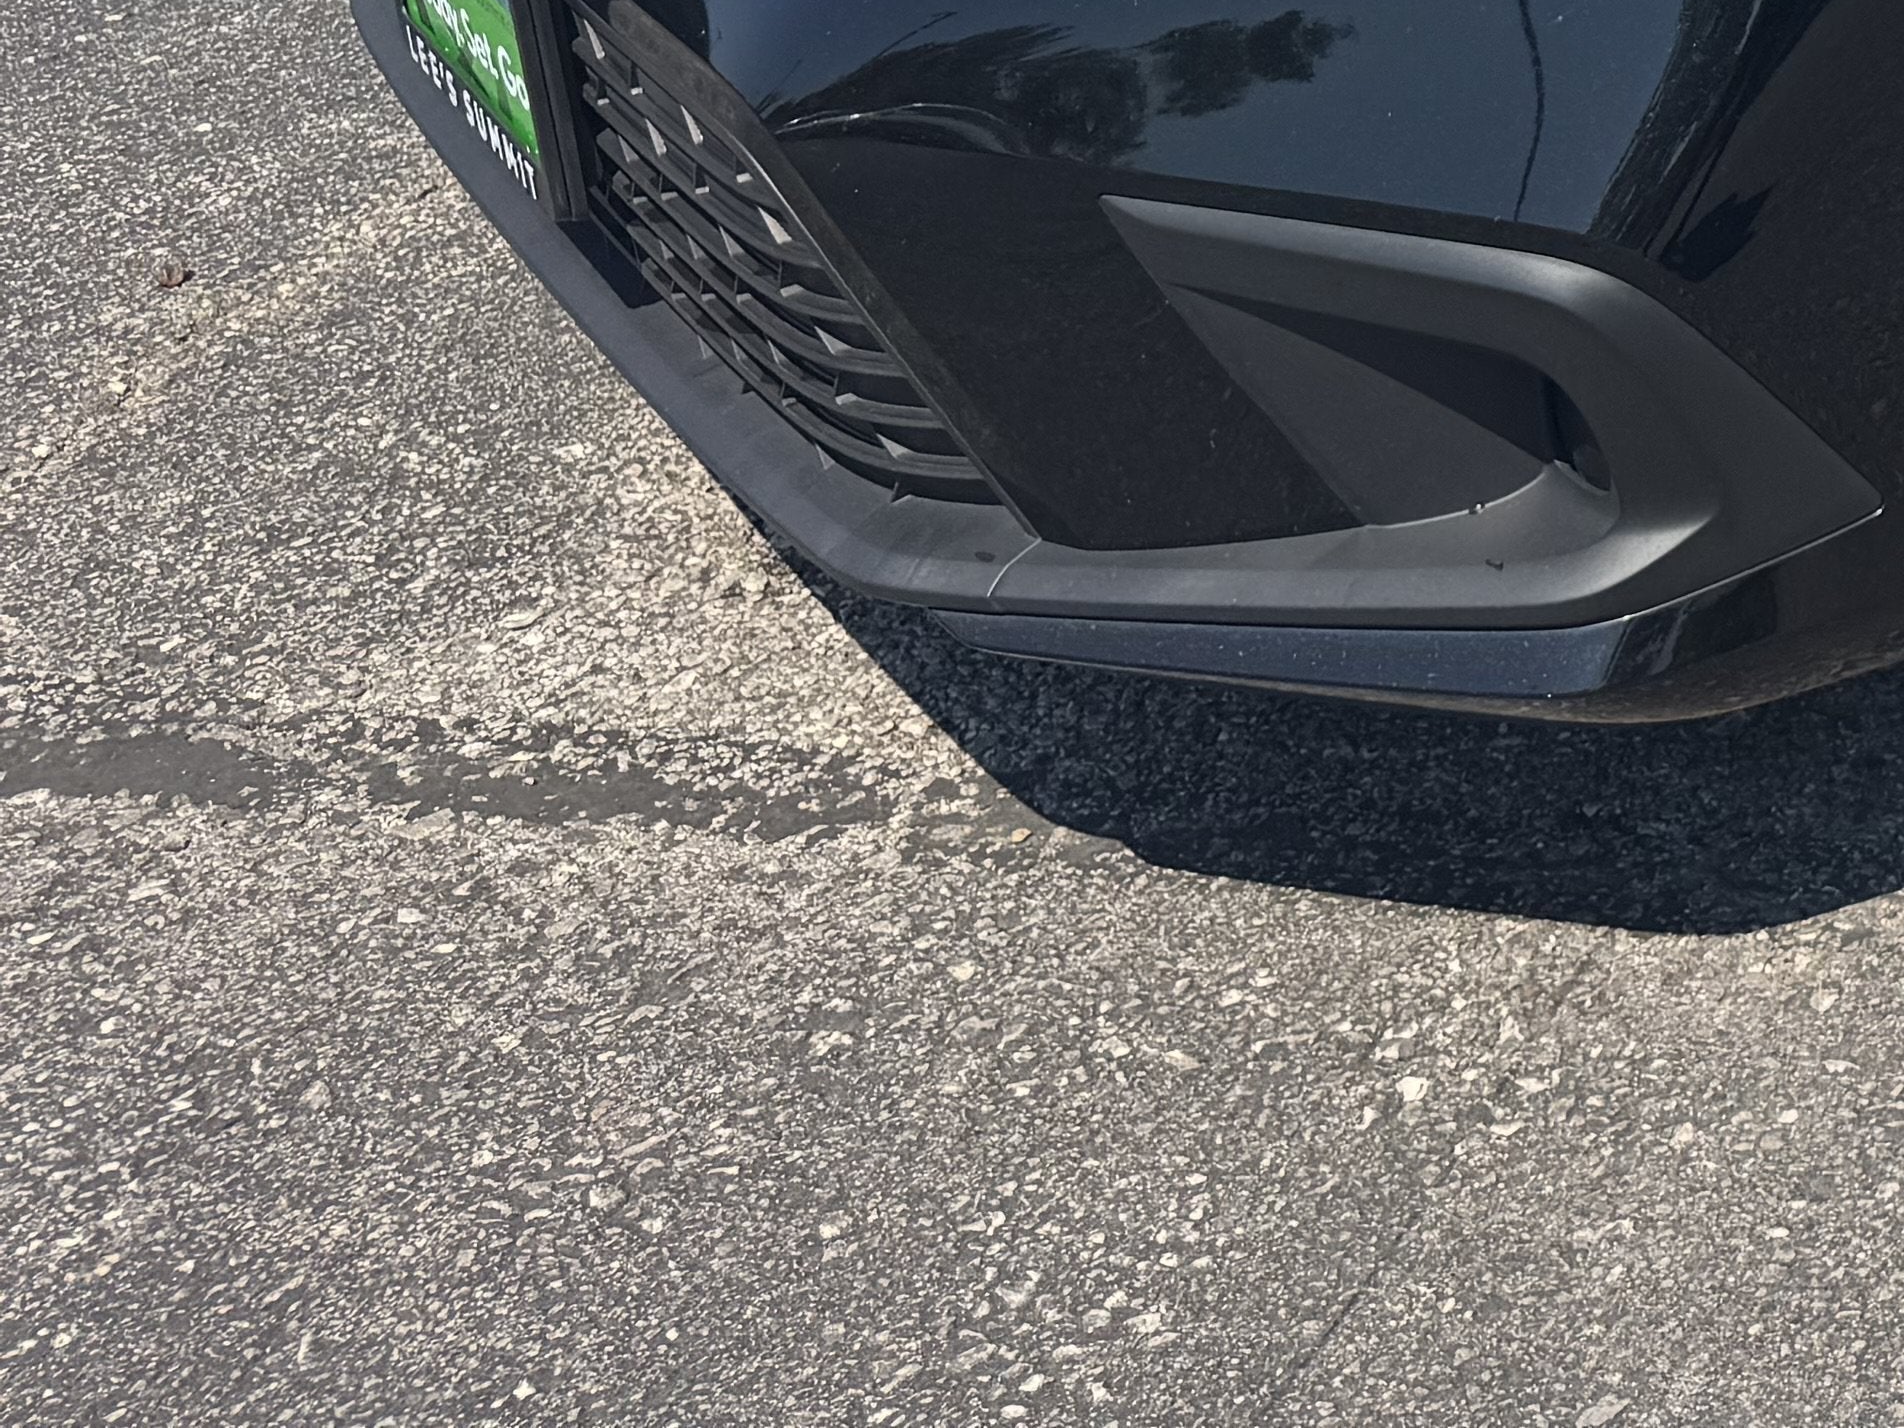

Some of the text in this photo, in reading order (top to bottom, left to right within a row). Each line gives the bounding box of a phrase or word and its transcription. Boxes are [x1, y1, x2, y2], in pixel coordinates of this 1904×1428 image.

[406, 25, 458, 107] LEE'S
[463, 89, 537, 200] SUMMIT
[498, 45, 530, 111] Go
